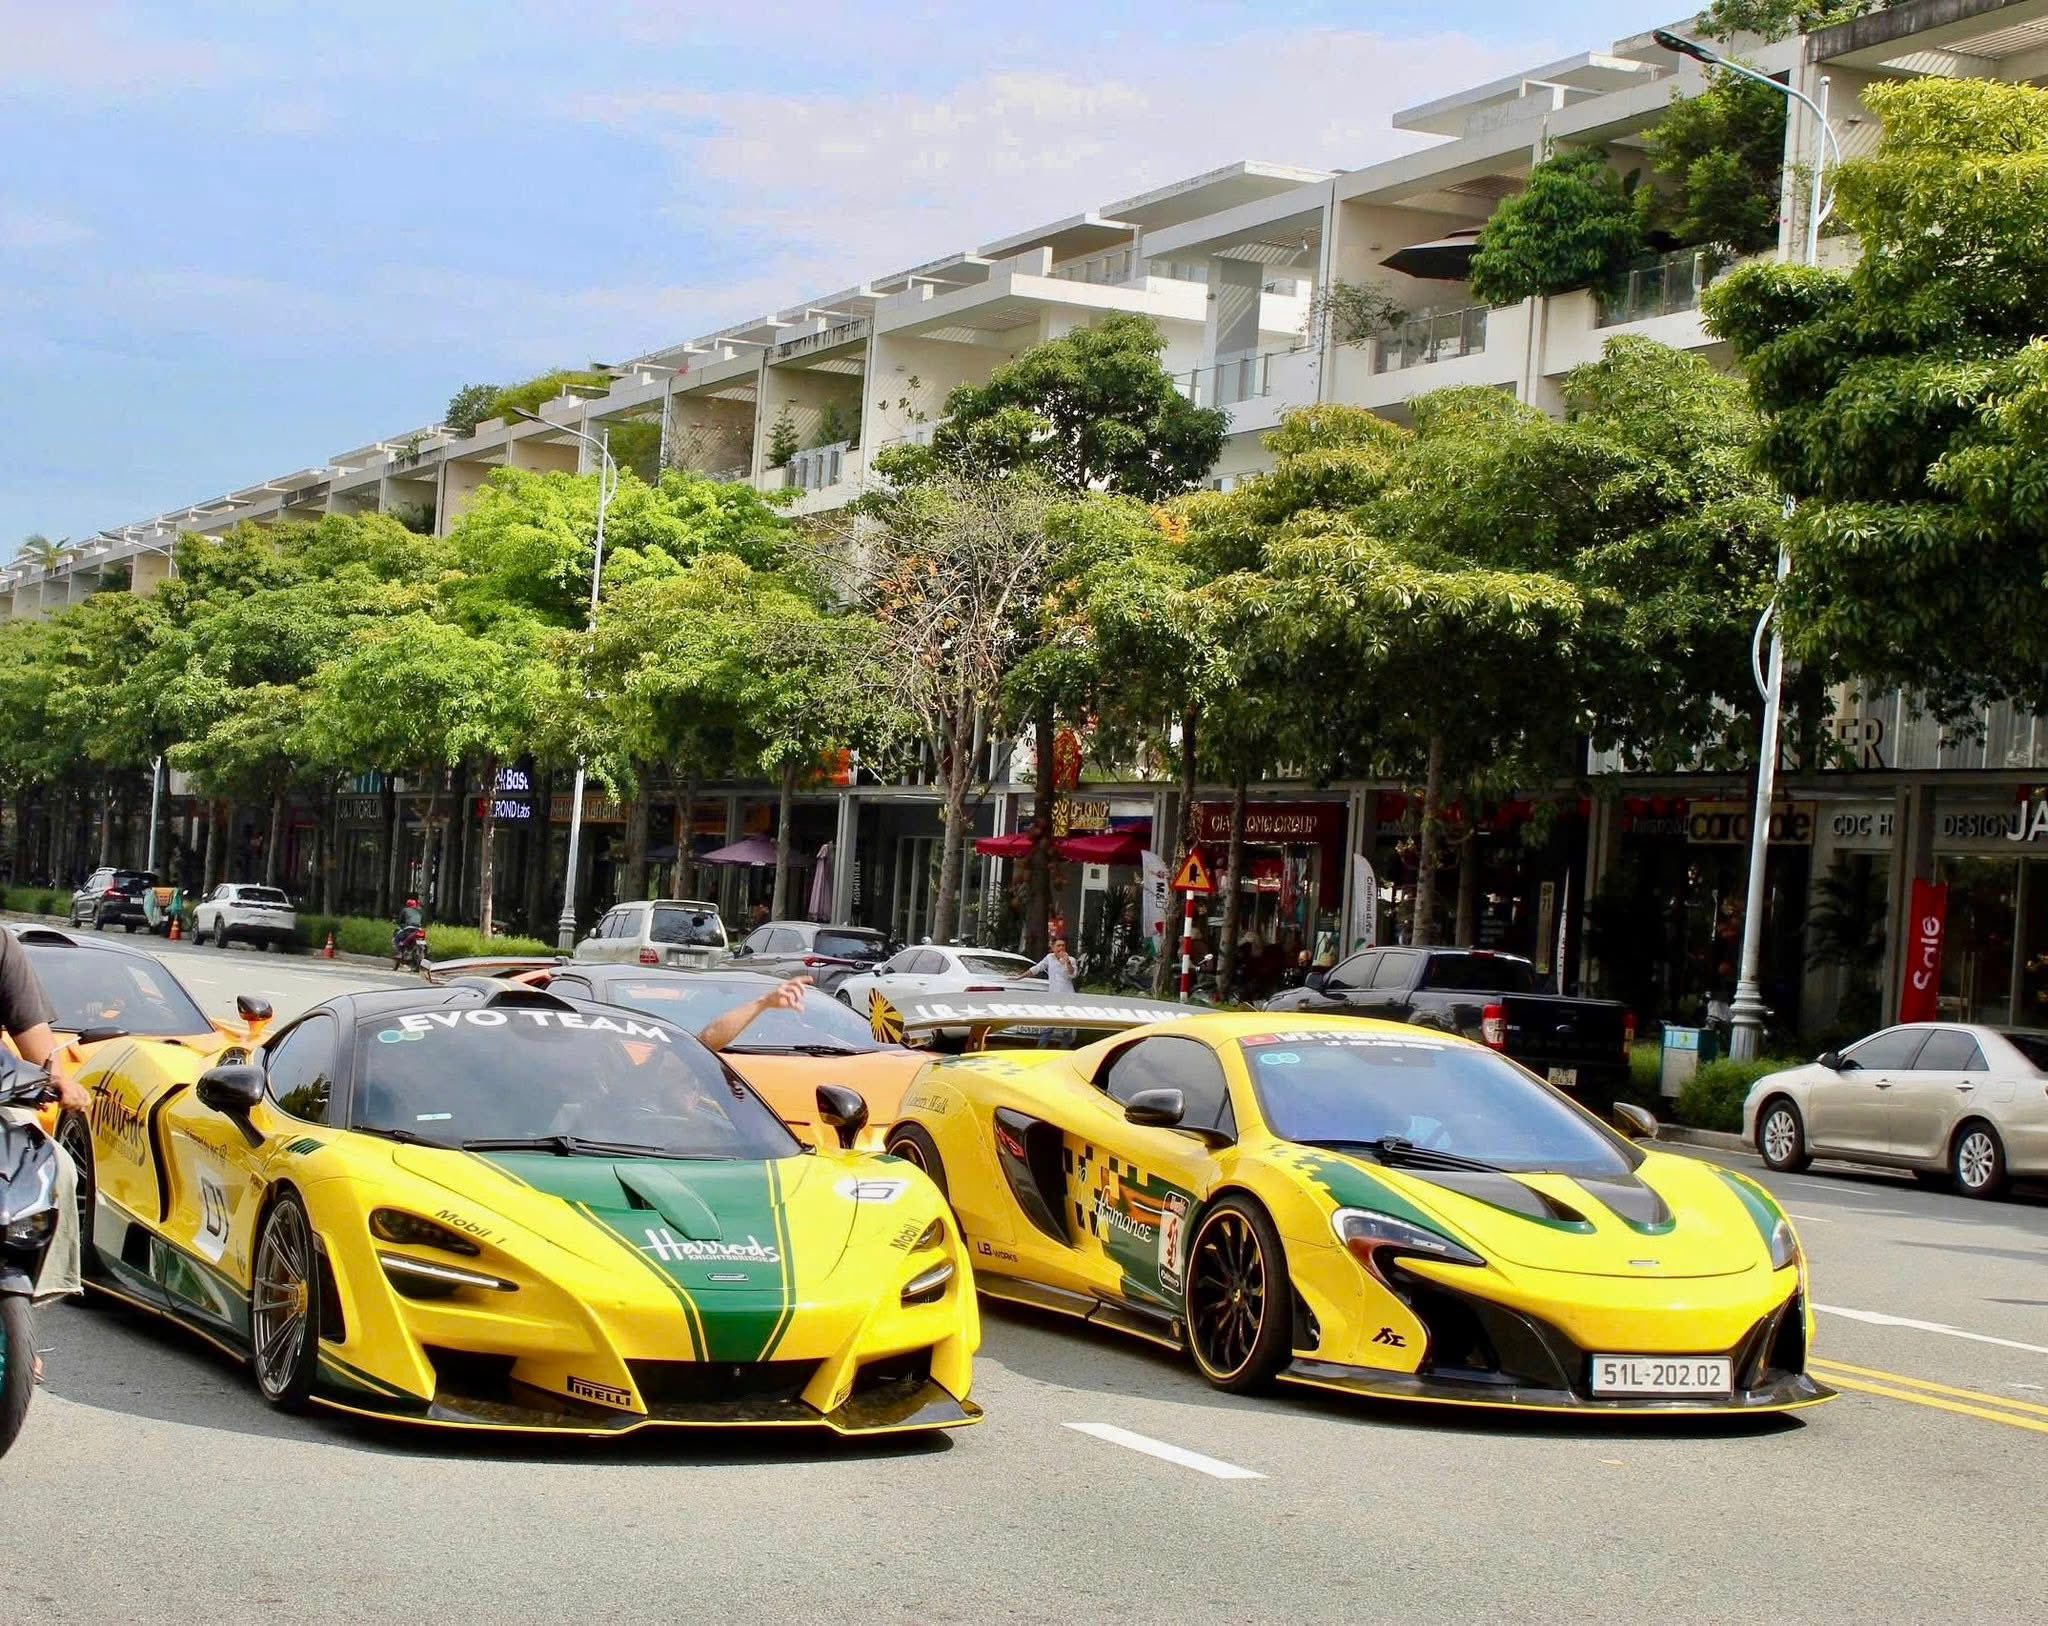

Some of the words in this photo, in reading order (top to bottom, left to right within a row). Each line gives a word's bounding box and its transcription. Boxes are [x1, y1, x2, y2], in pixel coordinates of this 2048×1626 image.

[1833, 814, 1871, 836] CDC
[399, 1010, 507, 1033] EVO
[518, 1010, 672, 1044] TEAM
[435, 1209, 493, 1238] Mobil
[889, 1224, 922, 1251] Mobil
[640, 1228, 781, 1263] Harrods
[1604, 1363, 1721, 1387] 51L-202.02
[566, 1375, 632, 1407] PIRELLI
